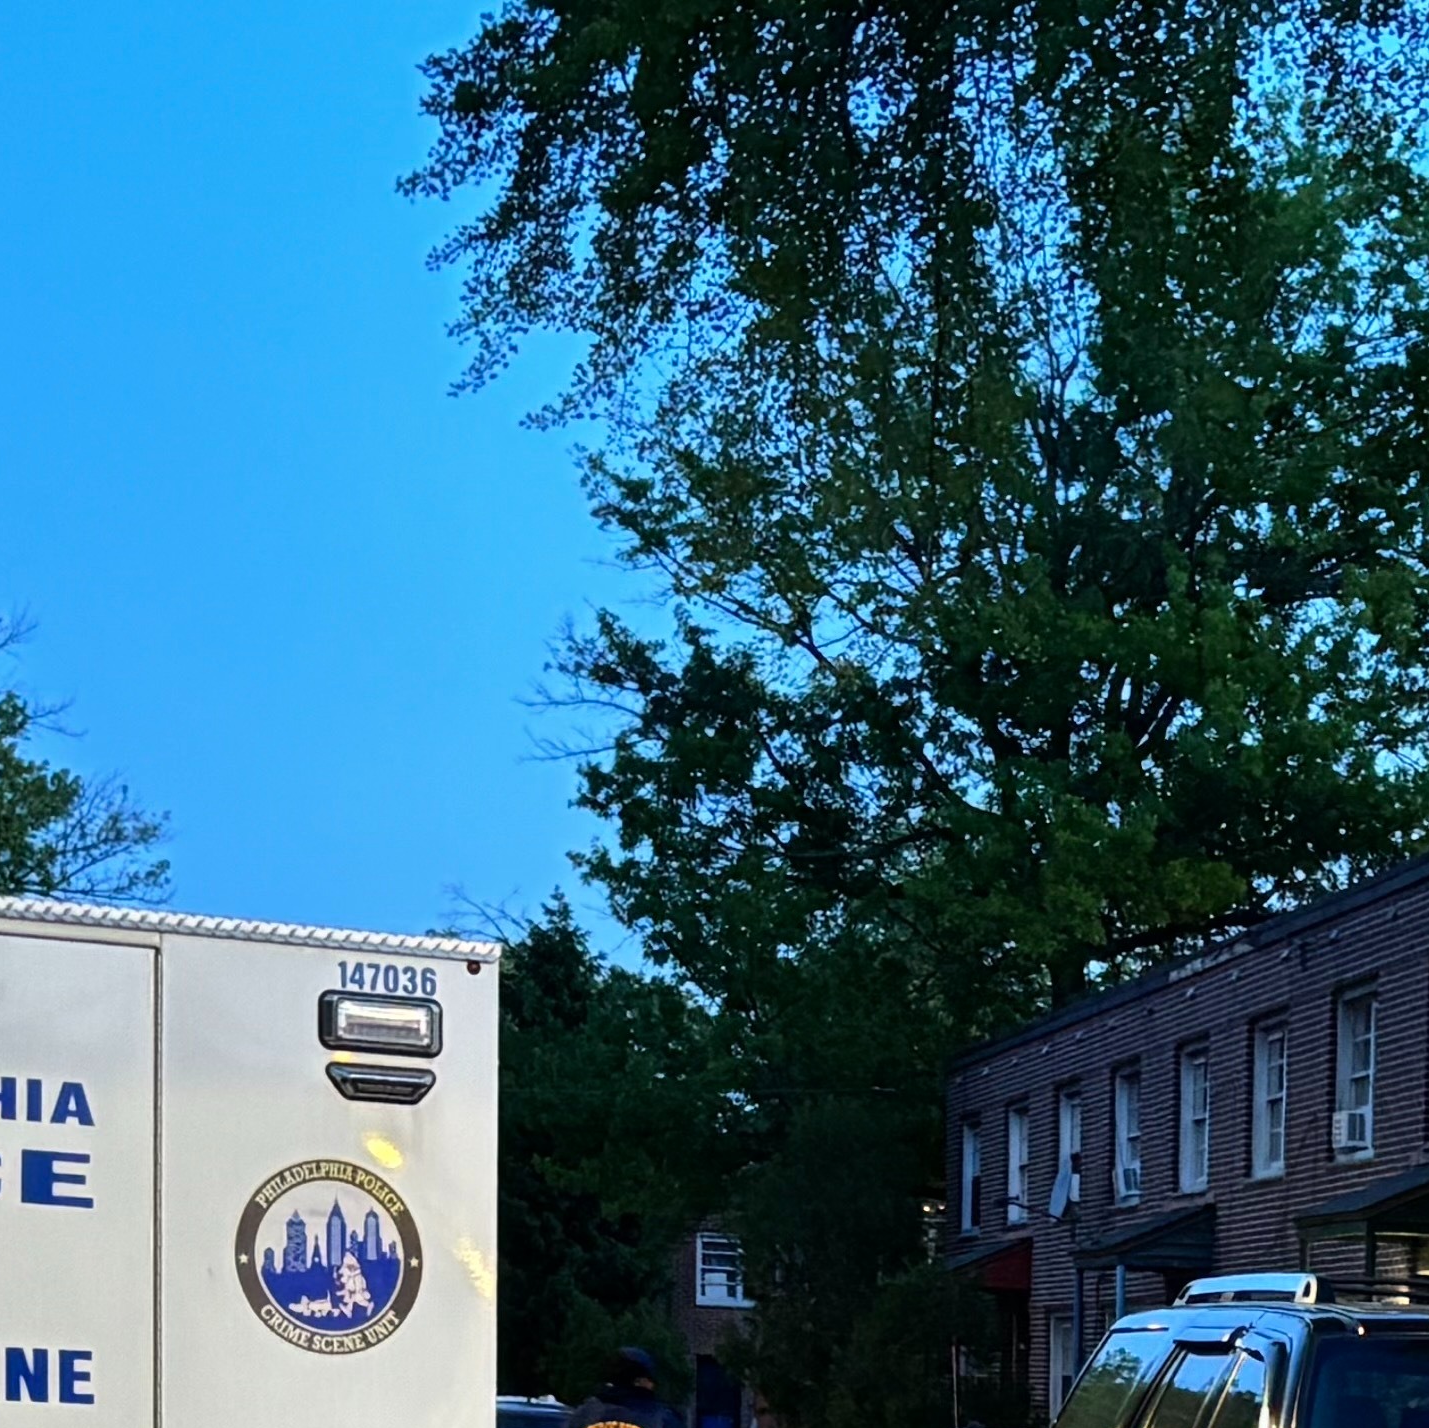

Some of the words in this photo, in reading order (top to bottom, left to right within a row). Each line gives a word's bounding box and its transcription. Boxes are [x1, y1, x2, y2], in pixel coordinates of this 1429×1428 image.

[337, 960, 438, 997] 147036
[254, 1161, 358, 1210] PHILADELPHIA
[355, 1170, 405, 1217] POLICE
[260, 1303, 311, 1350] CRIME
[311, 1334, 367, 1353] SCENE
[365, 1309, 402, 1344] UNIT
